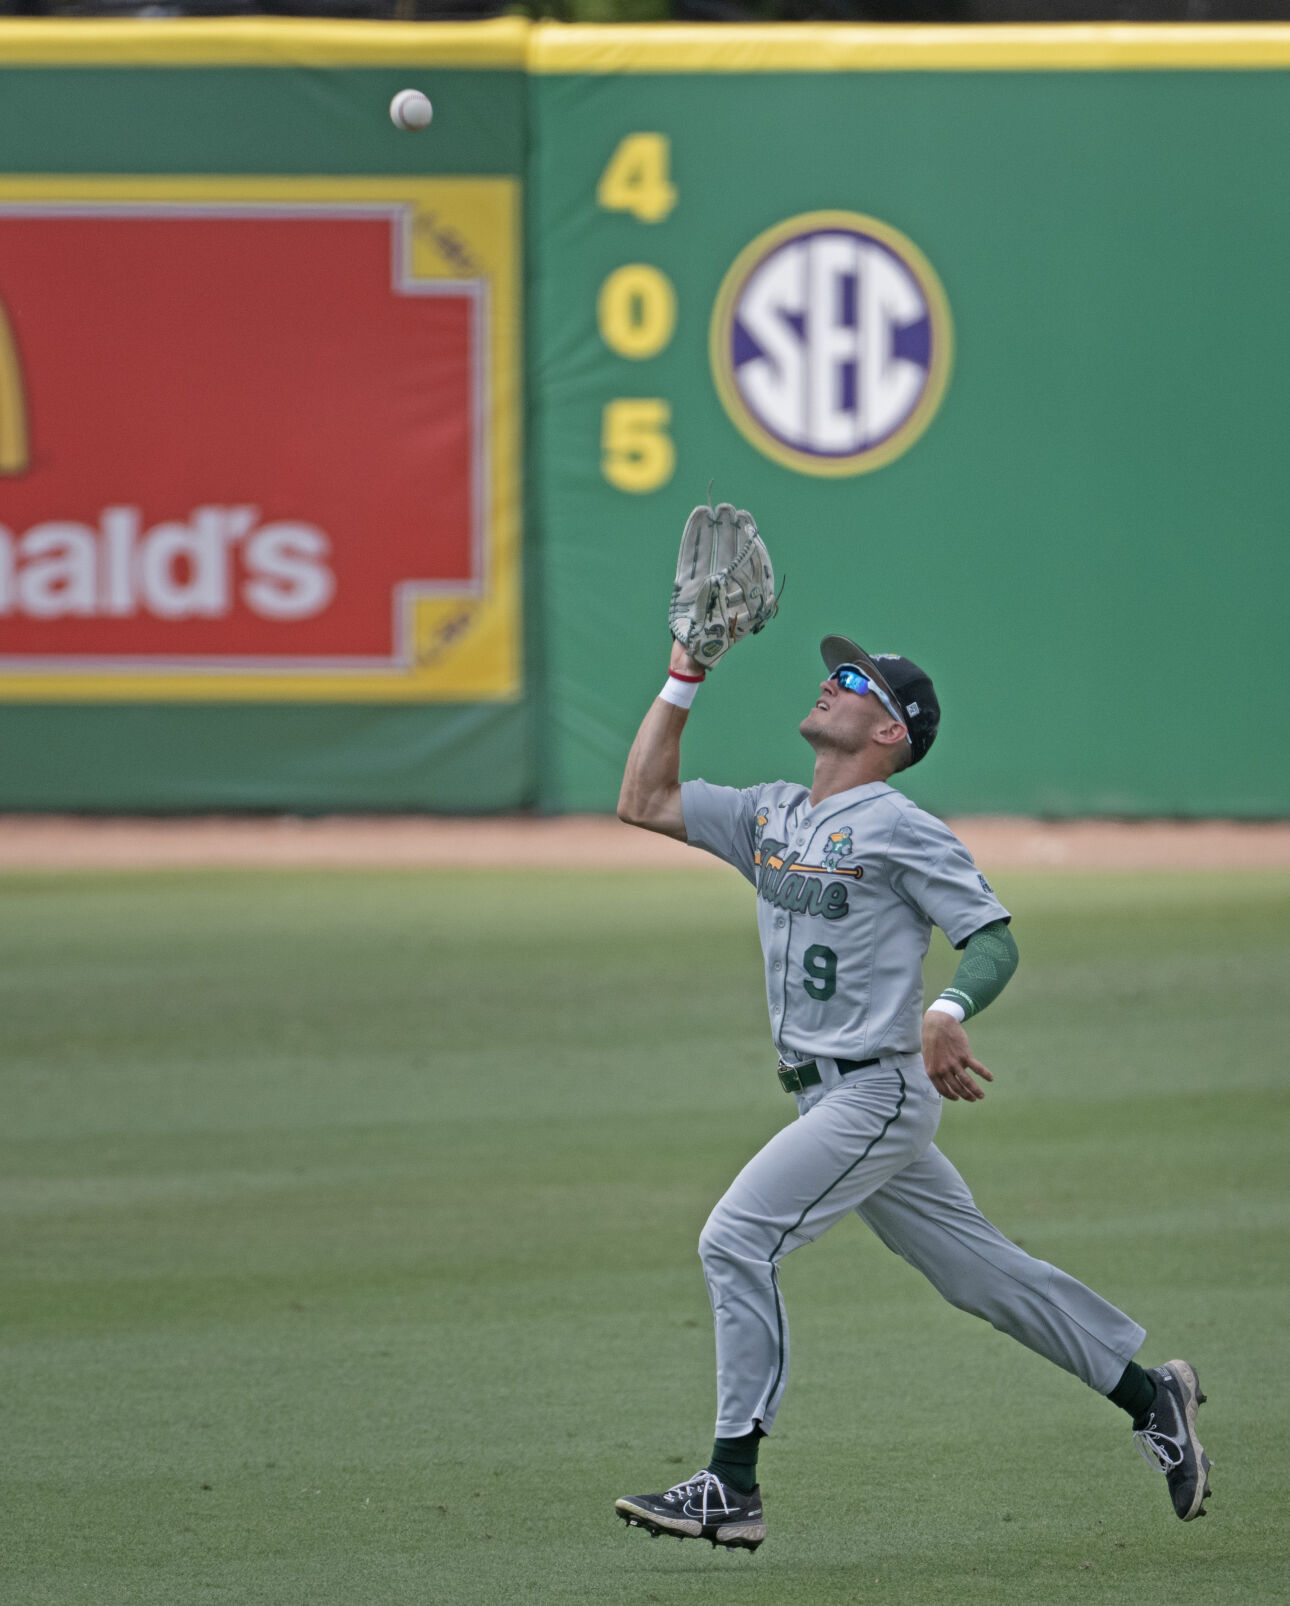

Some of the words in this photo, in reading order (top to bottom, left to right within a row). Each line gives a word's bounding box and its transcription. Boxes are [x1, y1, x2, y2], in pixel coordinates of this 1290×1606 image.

[737, 234, 927, 452] SEC
[0, 503, 336, 621] ald's
[760, 838, 849, 919] Tulane
[803, 943, 838, 1002] 9
